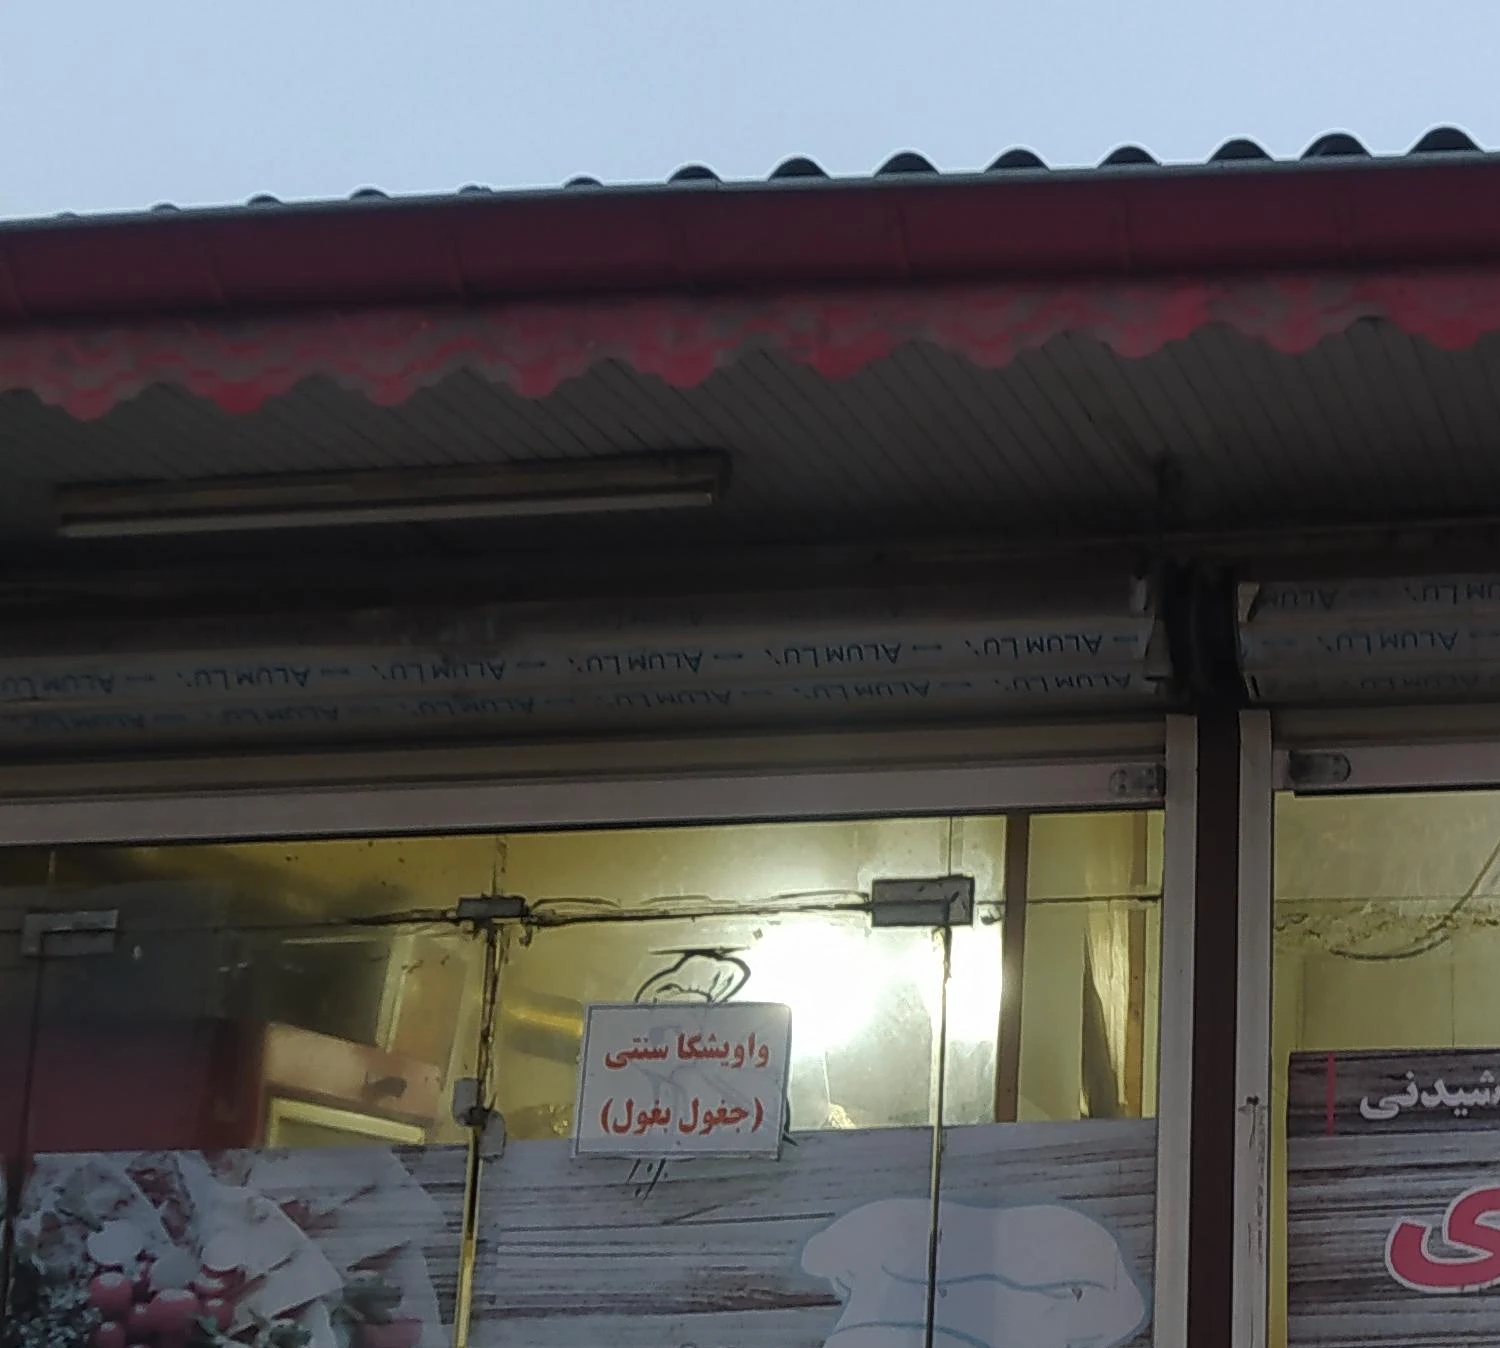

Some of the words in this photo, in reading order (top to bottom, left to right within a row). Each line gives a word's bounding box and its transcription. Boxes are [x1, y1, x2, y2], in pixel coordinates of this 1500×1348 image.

[0, 676, 115, 695] ALUMLU
[600, 687, 734, 709] ALUMLU
[603, 1037, 670, 1070] سنتی
[676, 1031, 770, 1069] واویشکا
